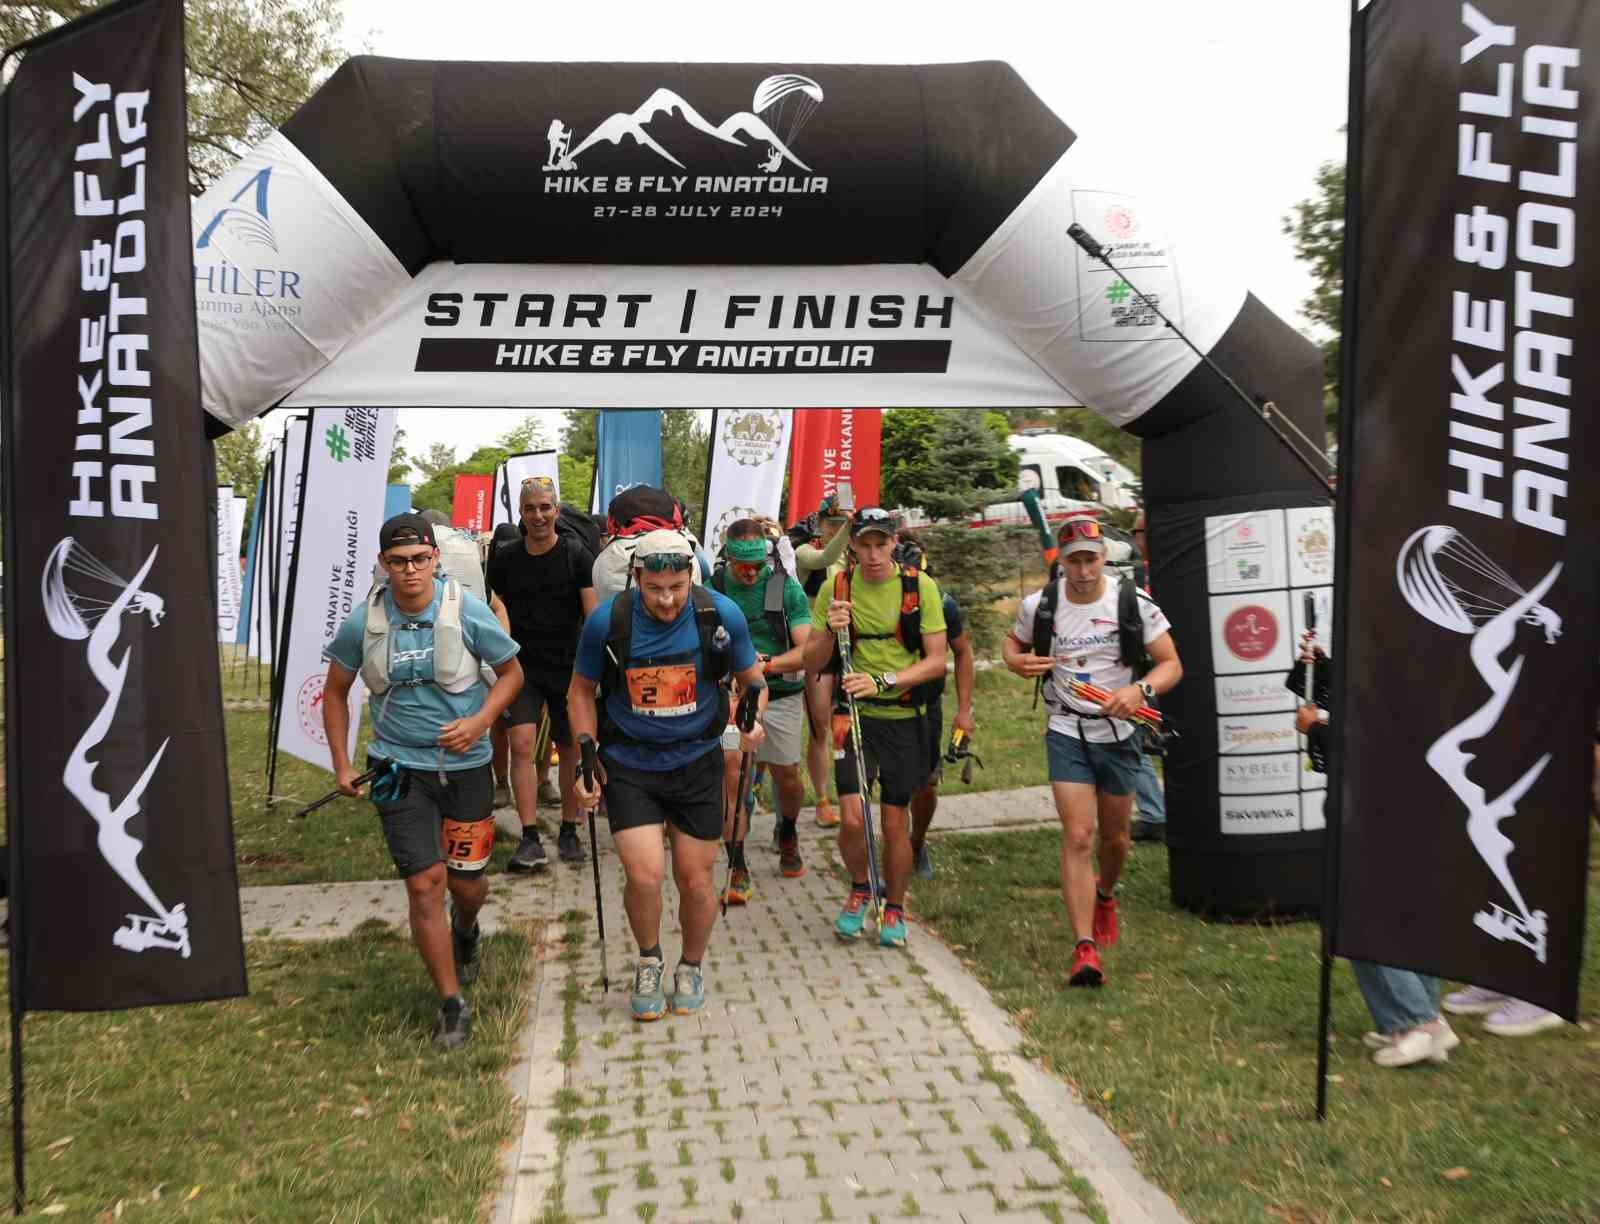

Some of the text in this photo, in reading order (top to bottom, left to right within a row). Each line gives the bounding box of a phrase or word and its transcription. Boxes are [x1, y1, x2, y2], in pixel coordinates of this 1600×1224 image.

[544, 176, 829, 193] HIKE & FLY ANATOLIA
[593, 206, 783, 217] 27-28 JULY 2024
[193, 260, 302, 299] HİLER
[1448, 2, 1516, 520] HIKE & FLY
[69, 71, 115, 518] HIKE & FLY
[108, 88, 159, 520] ANATOLIA
[1512, 44, 1581, 537] ANATOLIA
[424, 292, 653, 328] START
[724, 294, 955, 329] FINISH
[495, 344, 874, 367] HIKE & FLY ANATOLIA
[823, 448, 837, 470] VE
[343, 510, 359, 589] BAKANLIĞI
[330, 563, 344, 583] VE
[323, 585, 341, 640] SANAYİ
[641, 687, 658, 704] 2
[447, 839, 473, 858] 15
